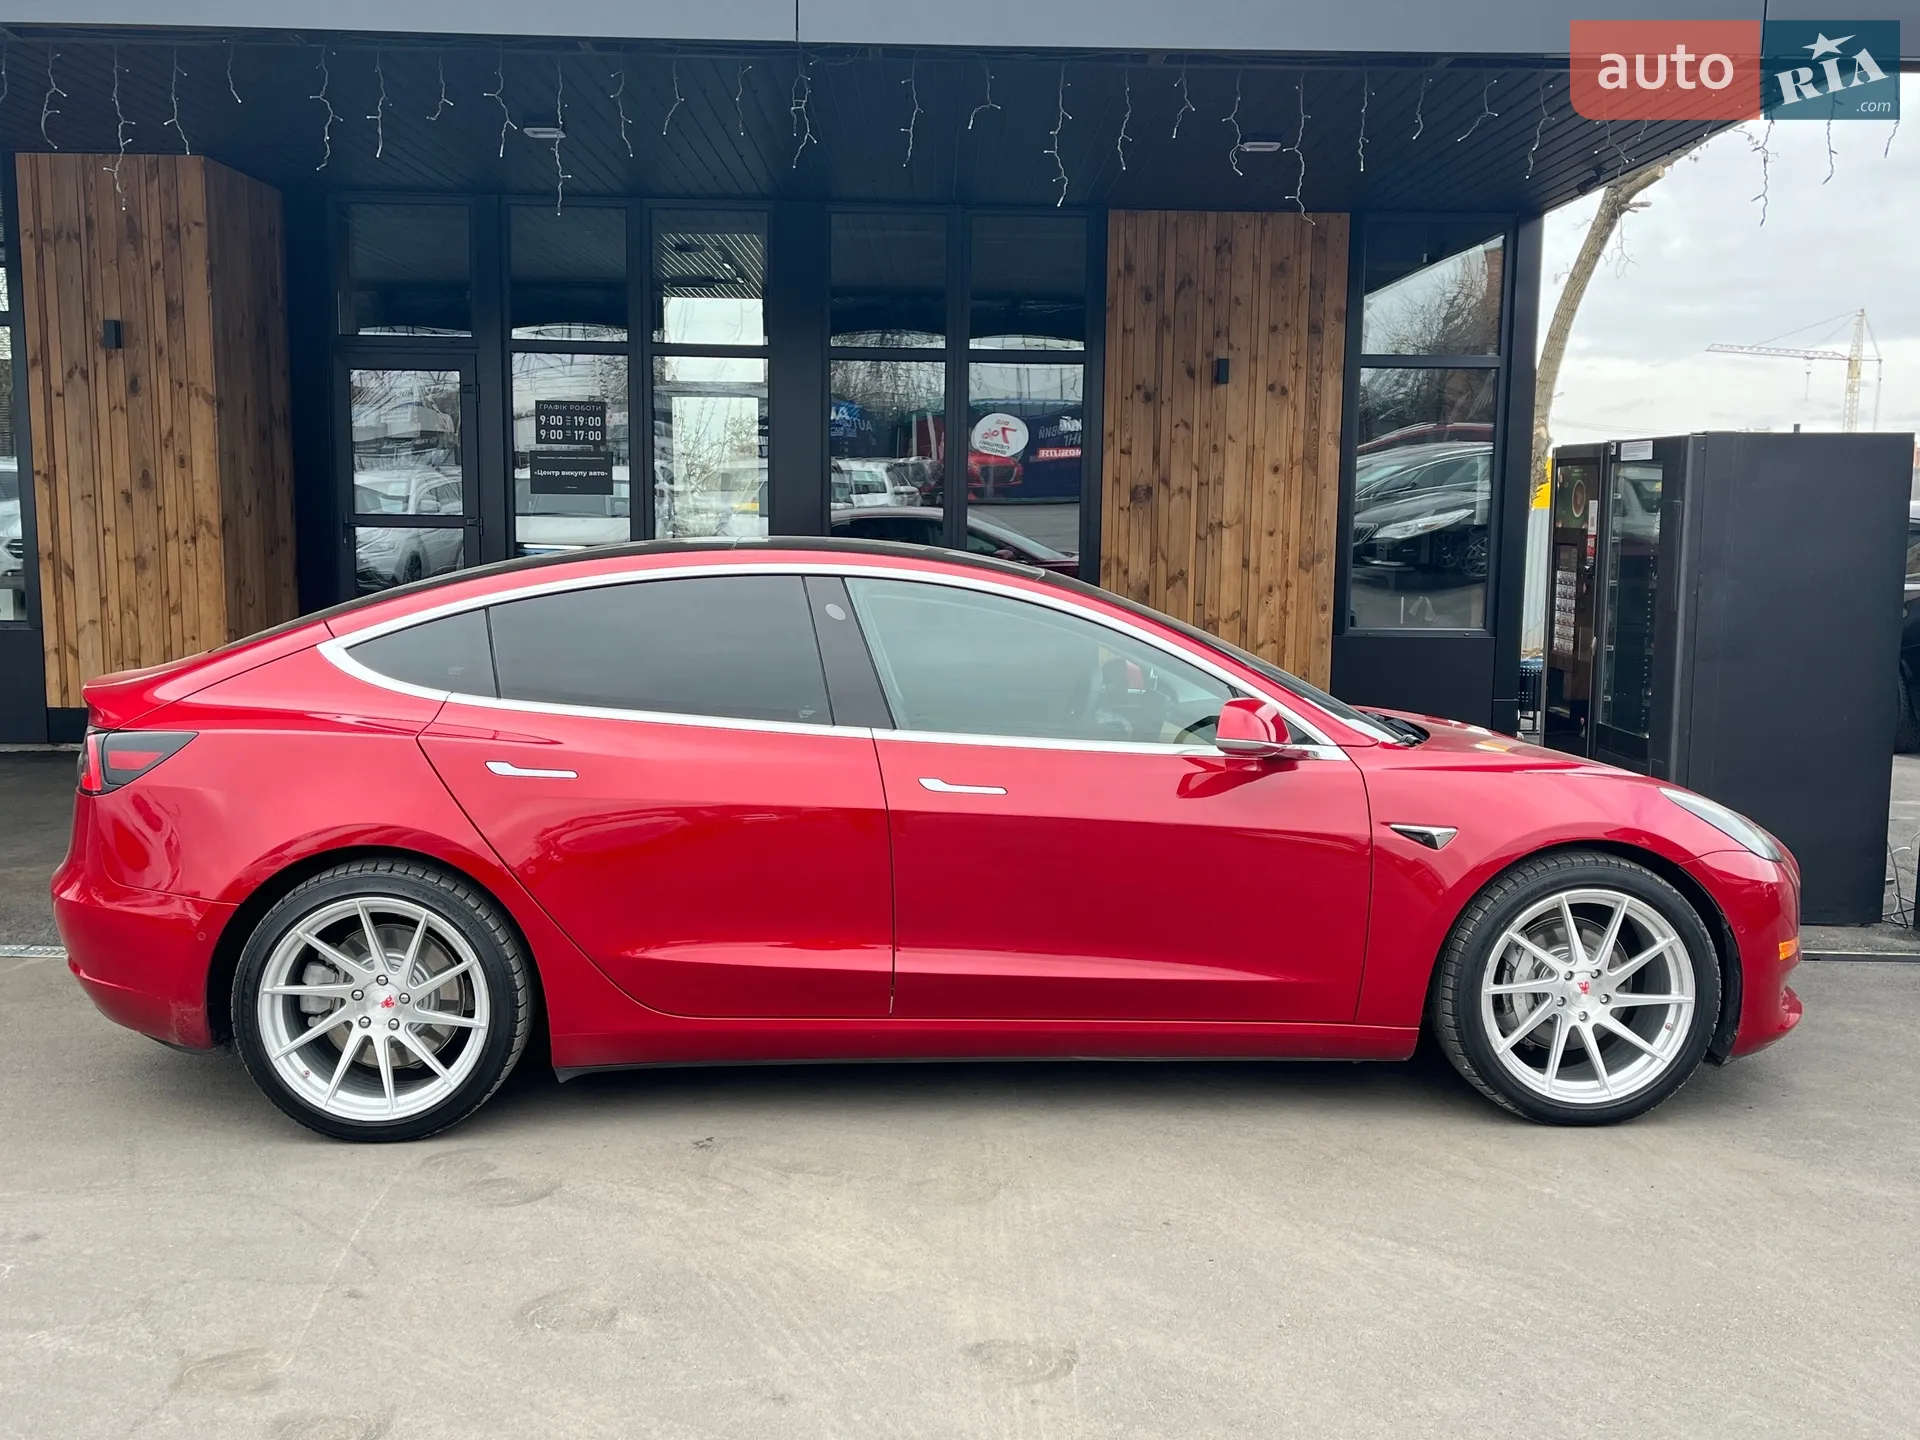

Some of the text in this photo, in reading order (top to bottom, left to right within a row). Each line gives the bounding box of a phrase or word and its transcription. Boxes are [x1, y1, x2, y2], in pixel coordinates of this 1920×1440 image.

[540, 415, 563, 425] 9:00
[573, 416, 601, 426] 19:00
[540, 429, 563, 440] 9:00
[574, 430, 601, 440] 17:00
[561, 470, 588, 478] викупу
